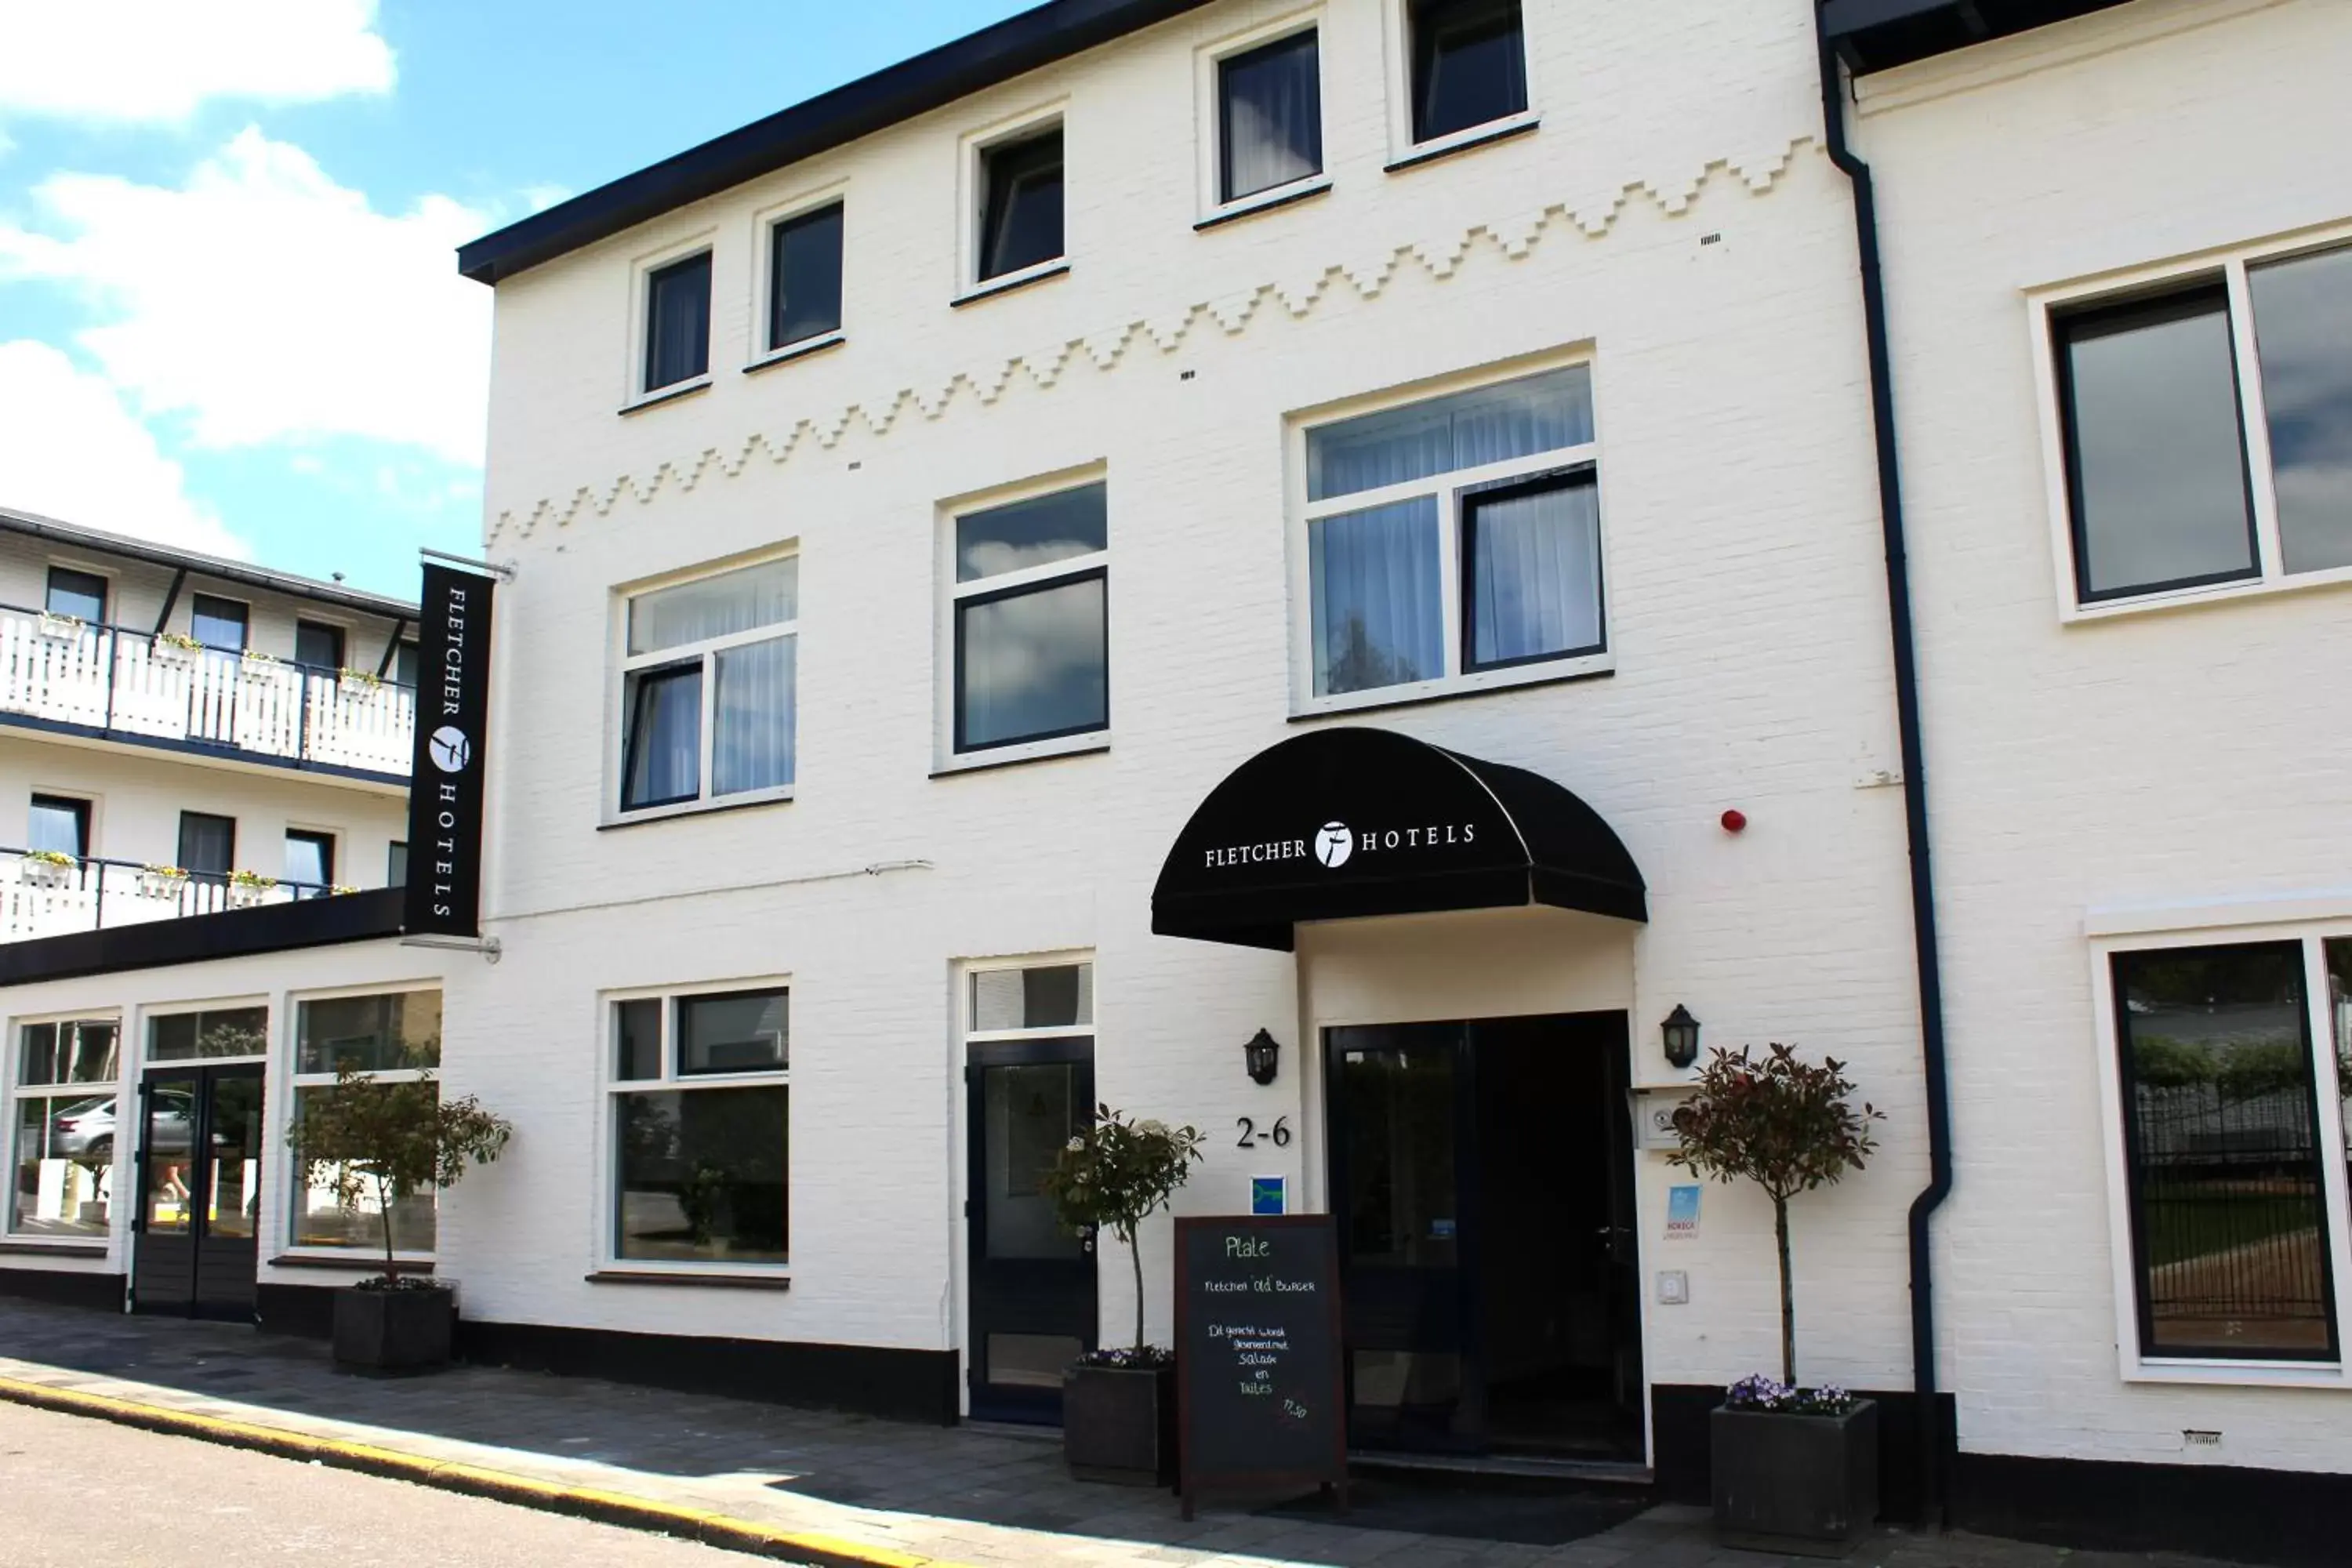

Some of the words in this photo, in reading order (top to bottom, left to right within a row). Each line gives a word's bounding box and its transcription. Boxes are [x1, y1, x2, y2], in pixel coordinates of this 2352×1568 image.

[442, 588, 466, 715] FLETCHER
[434, 783, 457, 916] HOTELS
[1205, 840, 1307, 868] FLETCHER
[1363, 824, 1475, 851] HOTELS
[1236, 1116, 1290, 1147] 2-6
[1225, 1236, 1270, 1258] Plate
